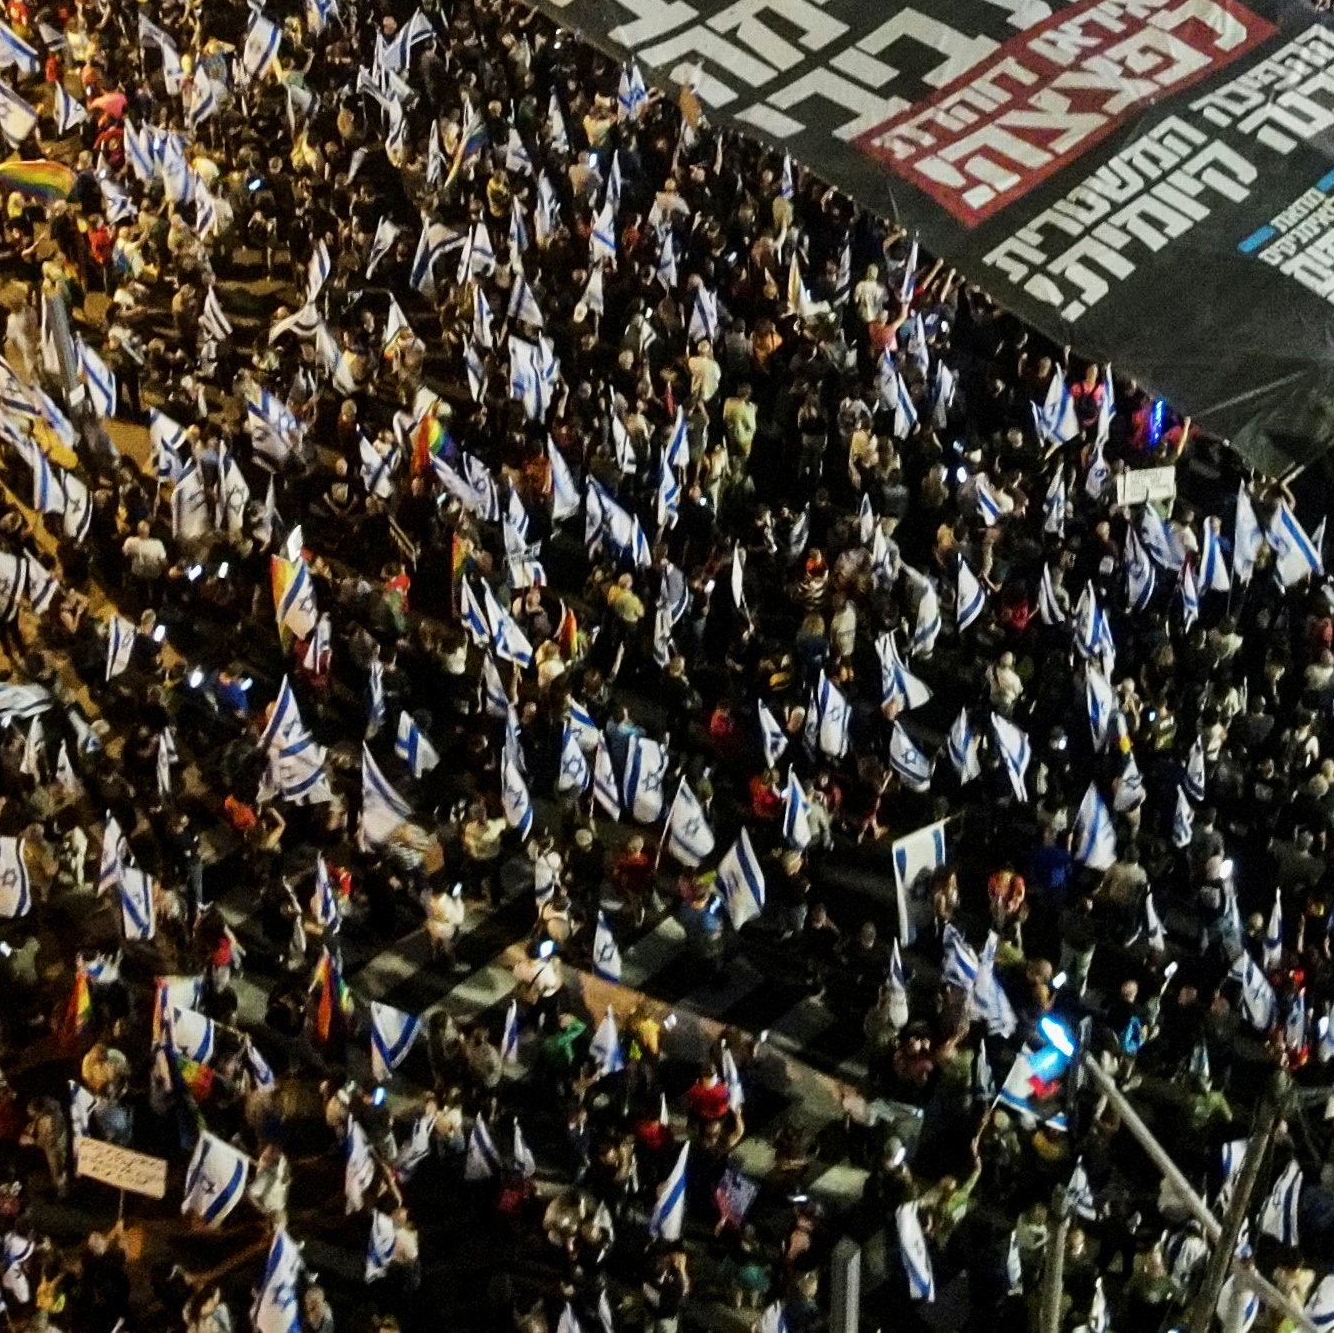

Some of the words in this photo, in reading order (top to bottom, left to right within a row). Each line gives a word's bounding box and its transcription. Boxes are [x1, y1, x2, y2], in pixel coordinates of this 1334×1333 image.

[734, 7, 1002, 143] ביבי
[870, 56, 1039, 160] דוהרת
[982, 115, 1208, 284] המשטרית
[1023, 139, 1258, 323] קיומית!
[1269, 186, 1327, 234] מחאת
